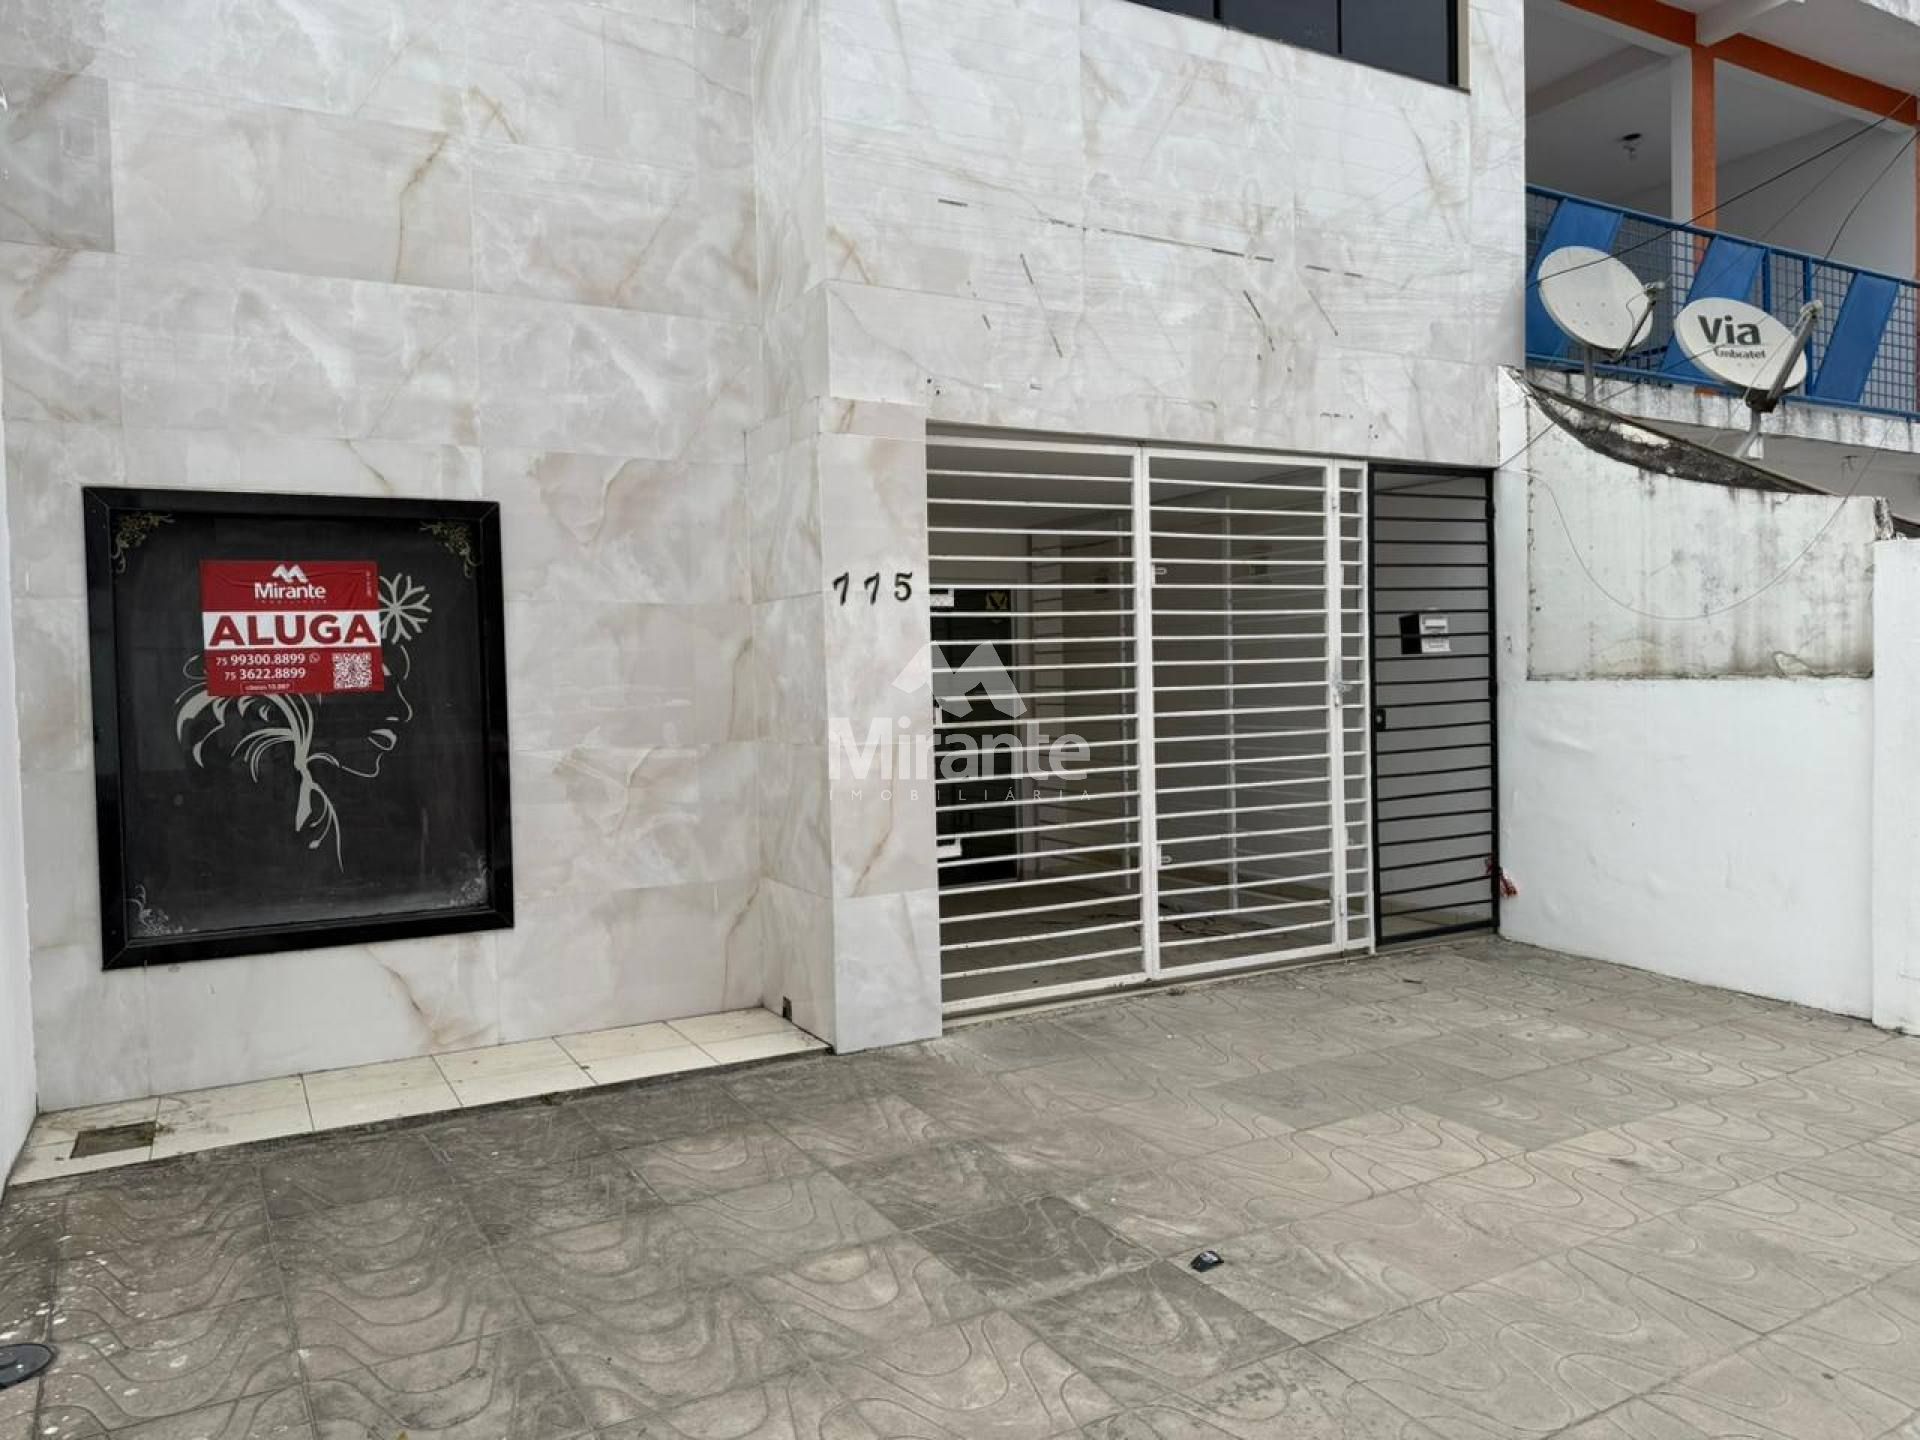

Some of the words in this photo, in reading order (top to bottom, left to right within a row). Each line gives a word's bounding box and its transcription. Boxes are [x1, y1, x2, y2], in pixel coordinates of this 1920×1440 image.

[1698, 315, 1761, 346] Via
[254, 582, 327, 599] Mirante
[832, 571, 913, 606] 775
[209, 614, 377, 646] ALUGA
[216, 656, 228, 667] 75
[230, 653, 305, 666] 99300.8899
[224, 671, 236, 681] 75
[239, 667, 306, 680] 3622.8899
